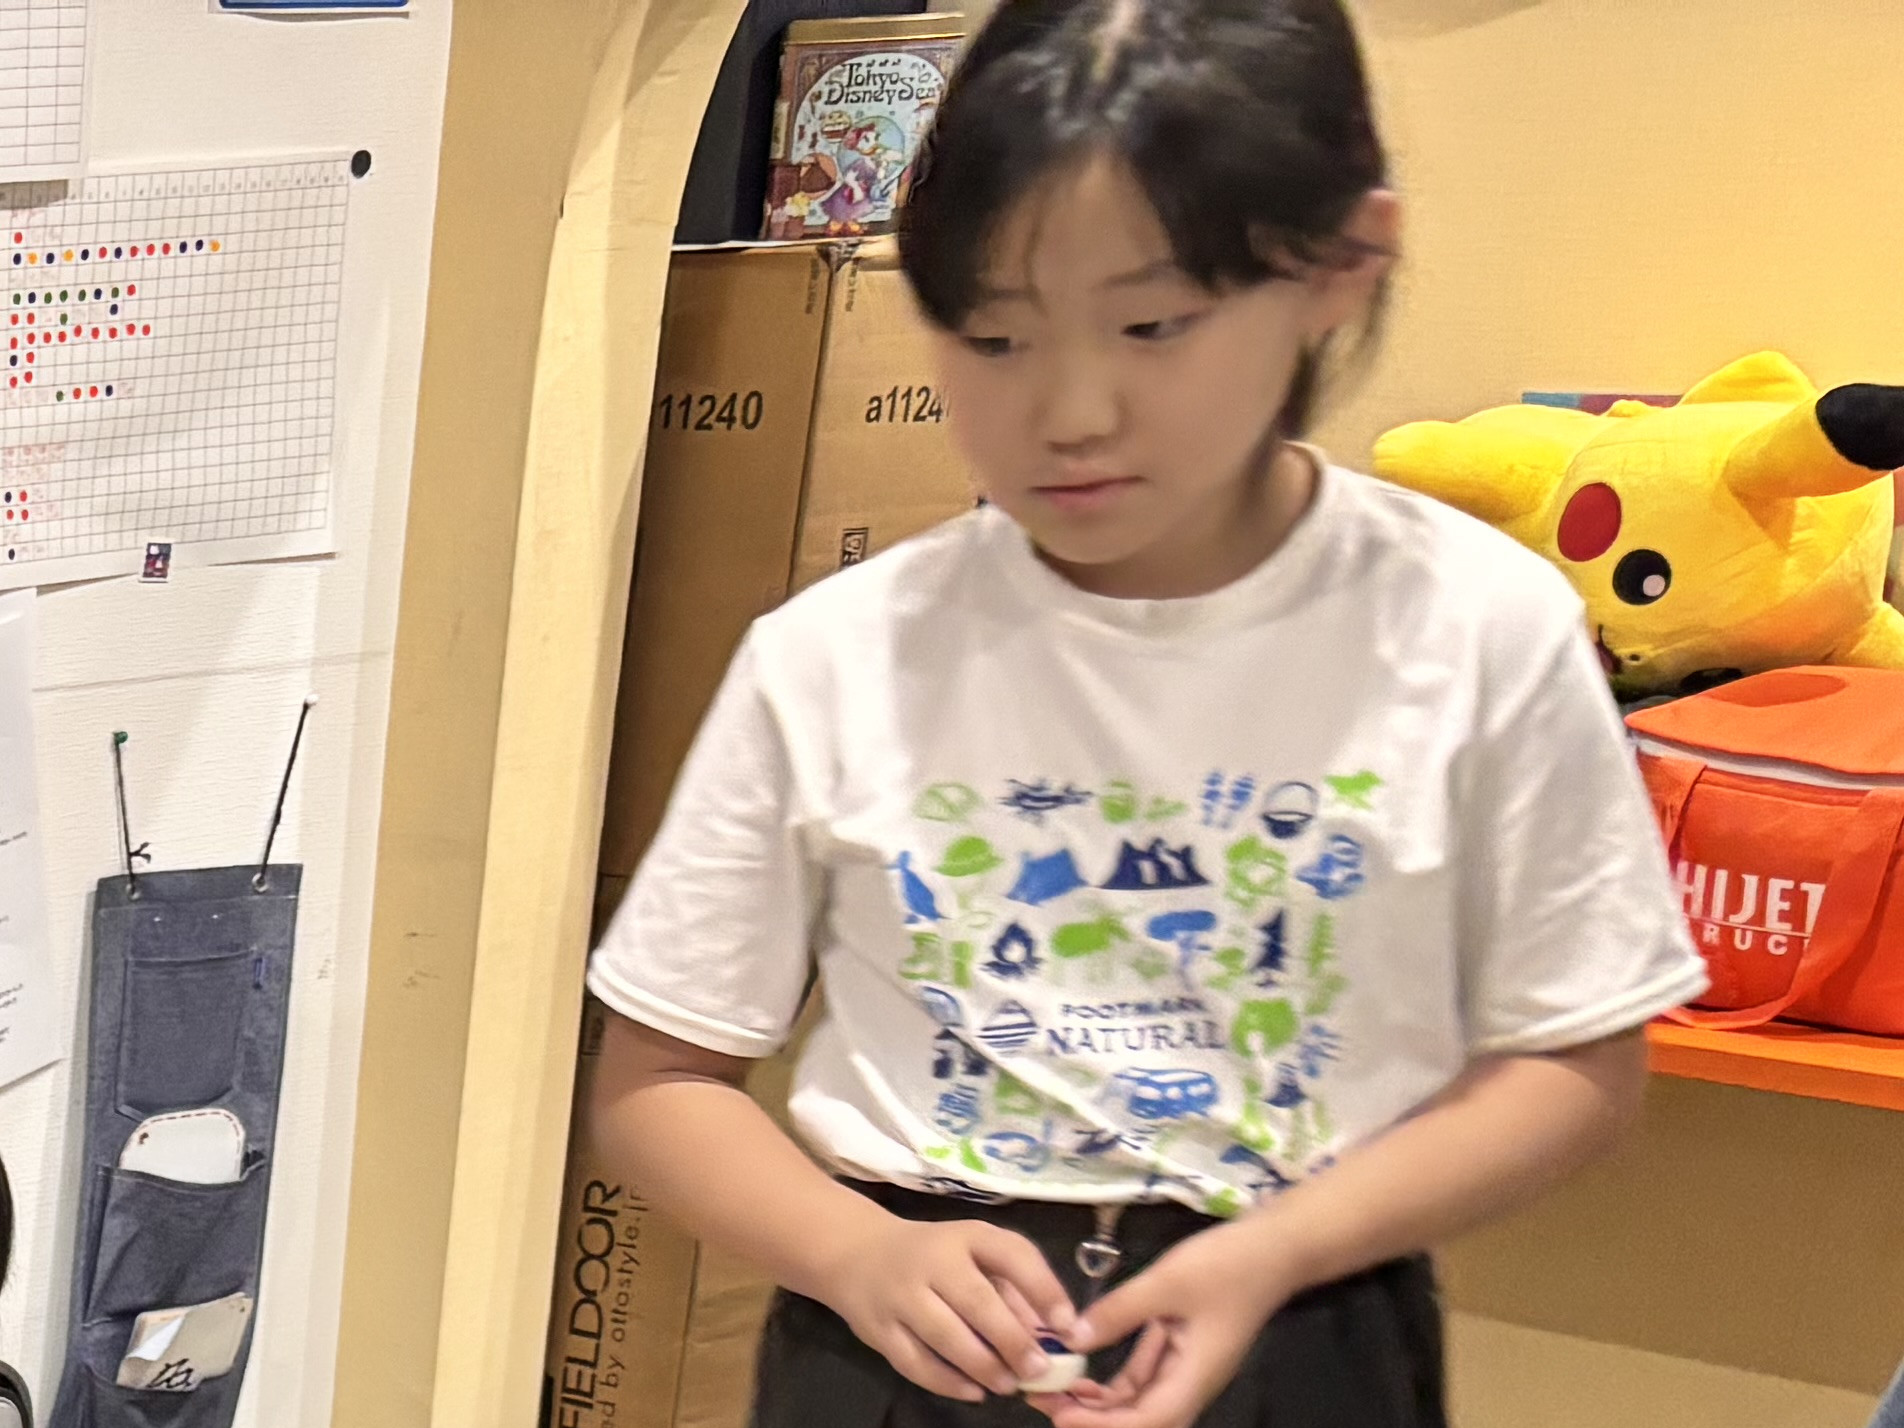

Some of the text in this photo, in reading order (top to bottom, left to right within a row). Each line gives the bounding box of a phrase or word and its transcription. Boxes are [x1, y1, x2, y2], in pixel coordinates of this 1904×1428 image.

[841, 62, 900, 89] Tokyo
[659, 390, 764, 432] 11240
[865, 386, 950, 423] a1124
[1676, 861, 1827, 935] HIJET
[1689, 920, 1810, 956] RUC
[1045, 1019, 1226, 1056] NATURAL
[599, 1355, 626, 1388] by
